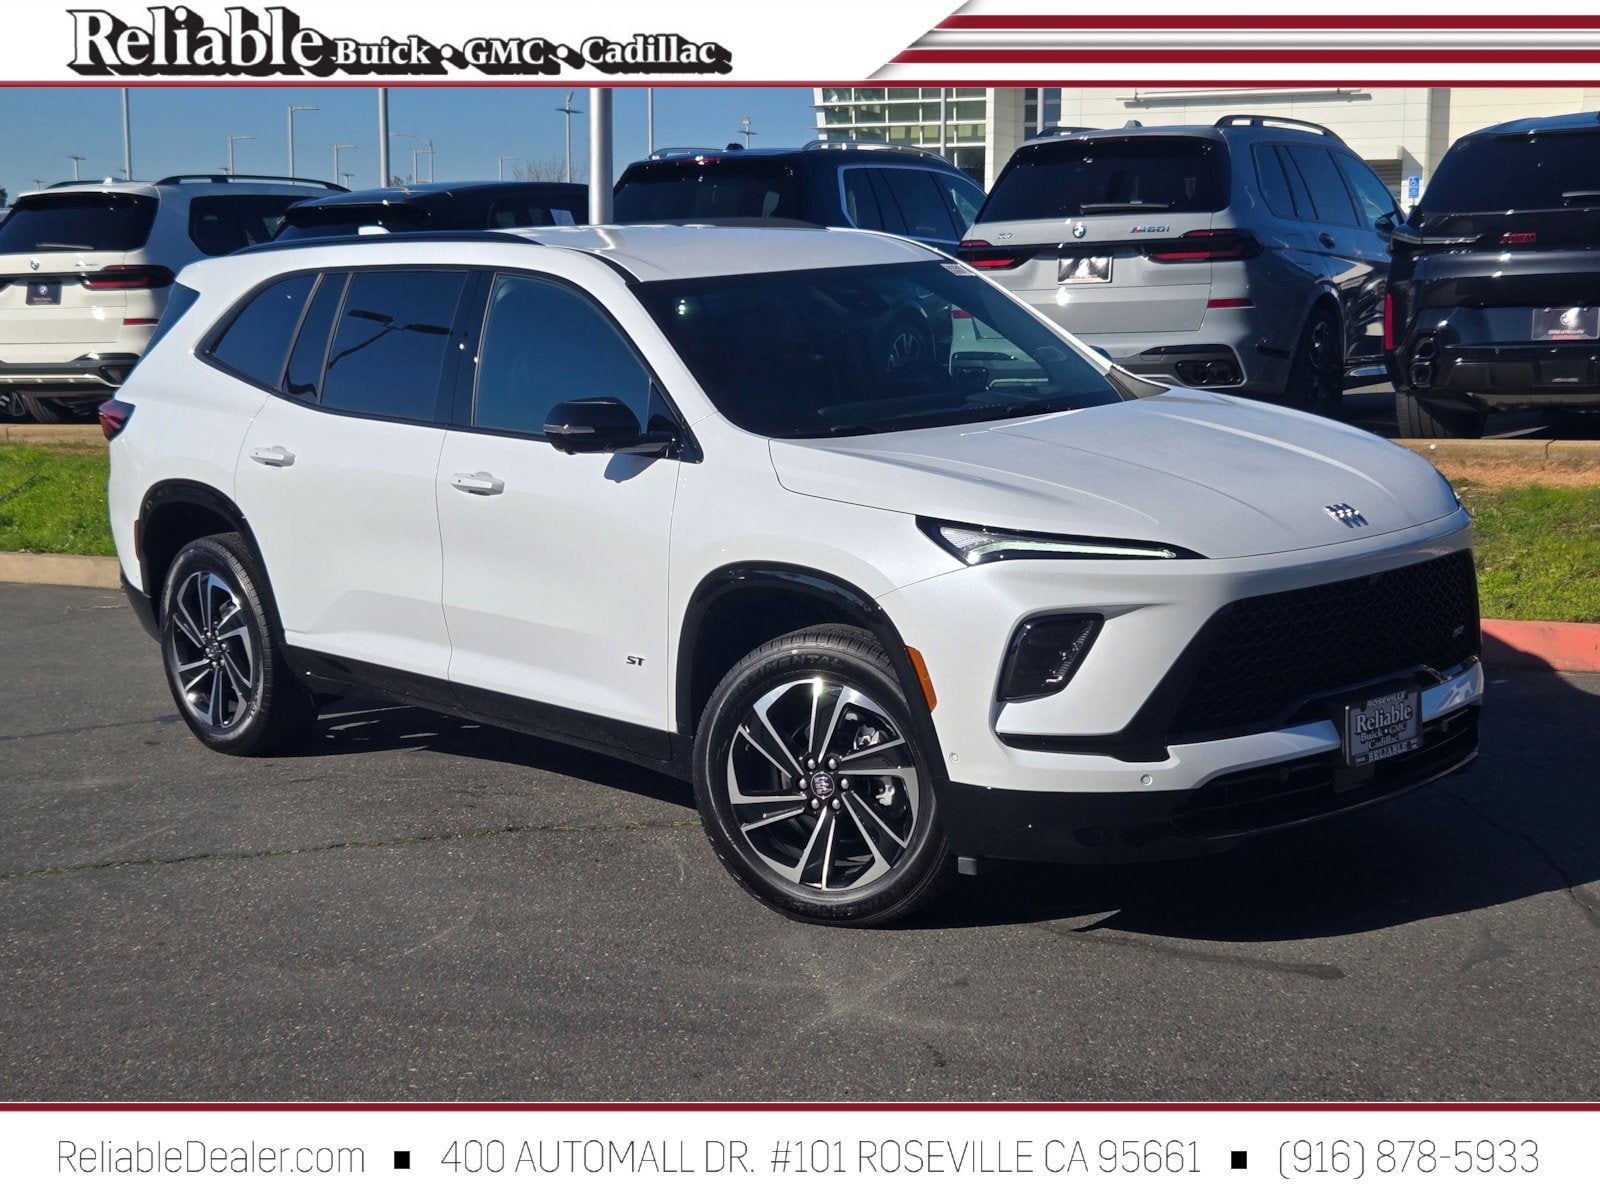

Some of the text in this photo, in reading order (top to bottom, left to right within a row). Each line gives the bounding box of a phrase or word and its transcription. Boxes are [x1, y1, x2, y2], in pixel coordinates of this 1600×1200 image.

[626, 655, 646, 667] ST
[1367, 692, 1405, 706] ROSEVILLE
[1356, 702, 1412, 733] Reliable
[1361, 722, 1407, 742] Buick GMC
[1368, 735, 1399, 750] Cadillac
[1368, 742, 1408, 762] RELIABLE
